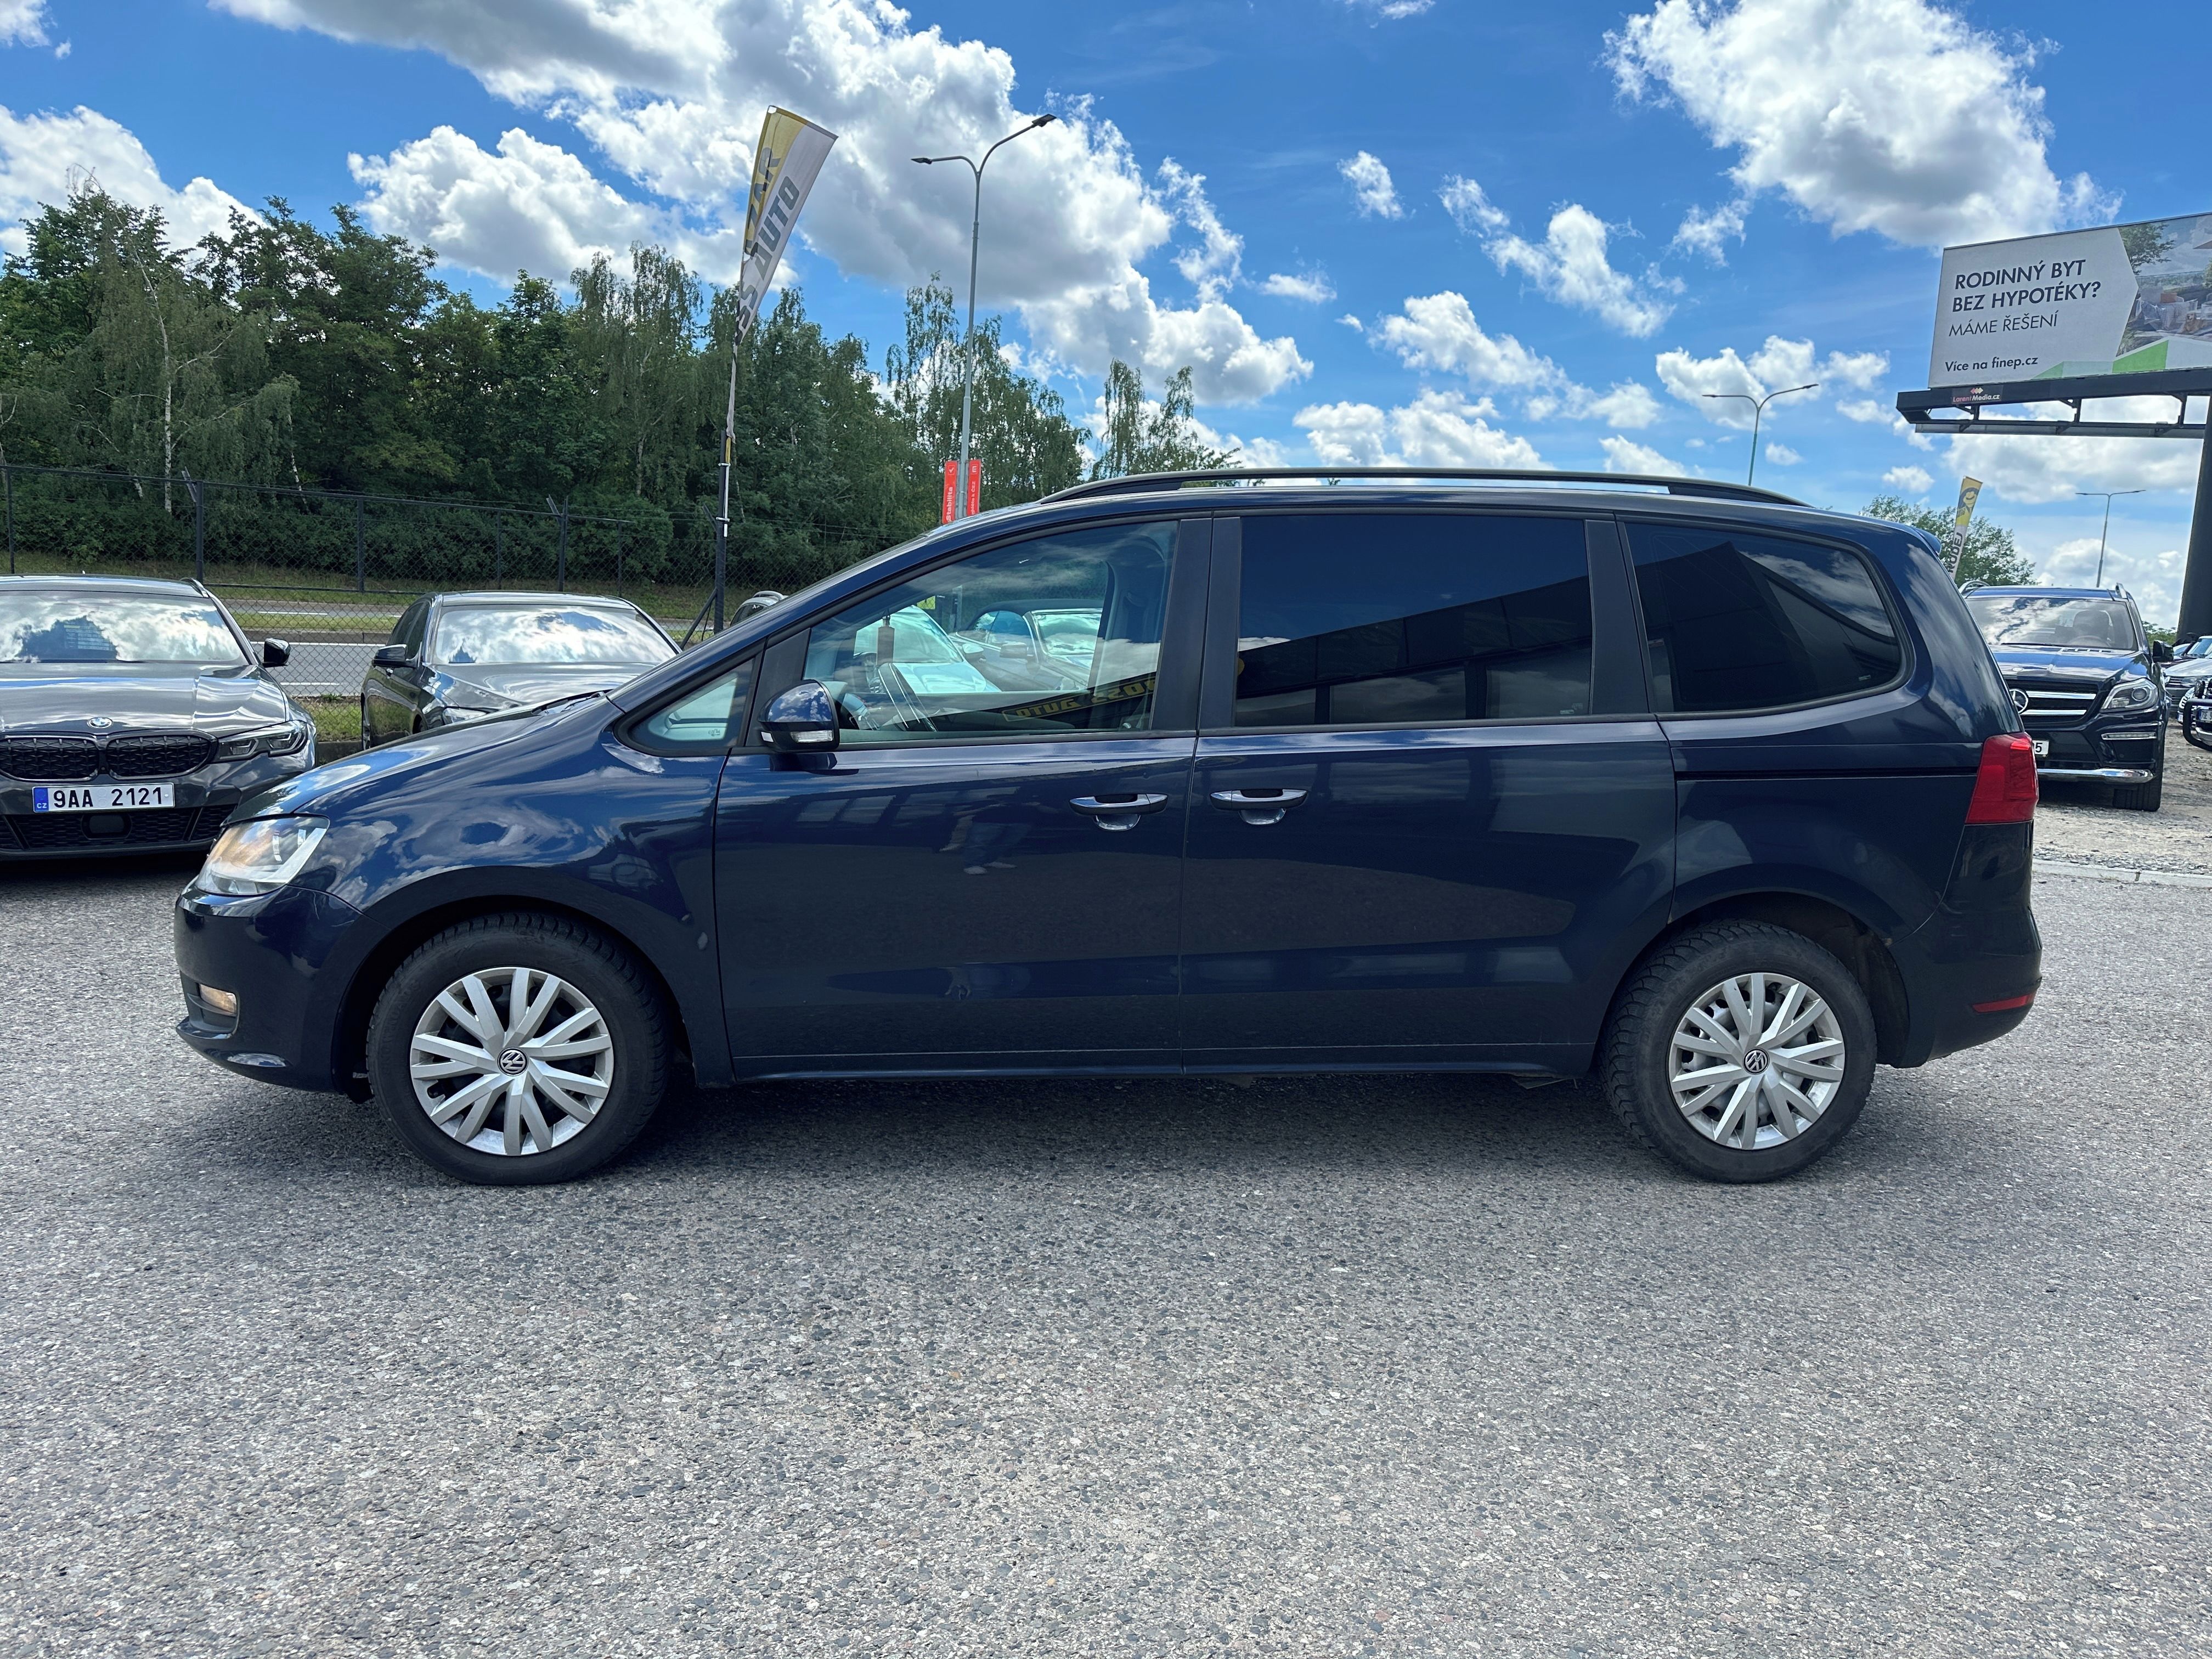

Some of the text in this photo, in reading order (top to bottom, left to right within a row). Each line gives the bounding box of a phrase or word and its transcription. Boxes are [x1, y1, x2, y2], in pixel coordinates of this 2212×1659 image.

[751, 176, 800, 281] AUTO
[1955, 259, 2086, 290] RODINNÝ BYT
[1952, 281, 2101, 312] BEZ HYPOTÉKY?
[1949, 310, 2059, 336] MÁME ŘEŠENÍ
[1945, 357, 2039, 372] Více na finep.cz
[945, 487, 953, 522] Stabilita
[1948, 532, 1962, 573] RODEJ
[53, 787, 162, 808] 9AA 2121
